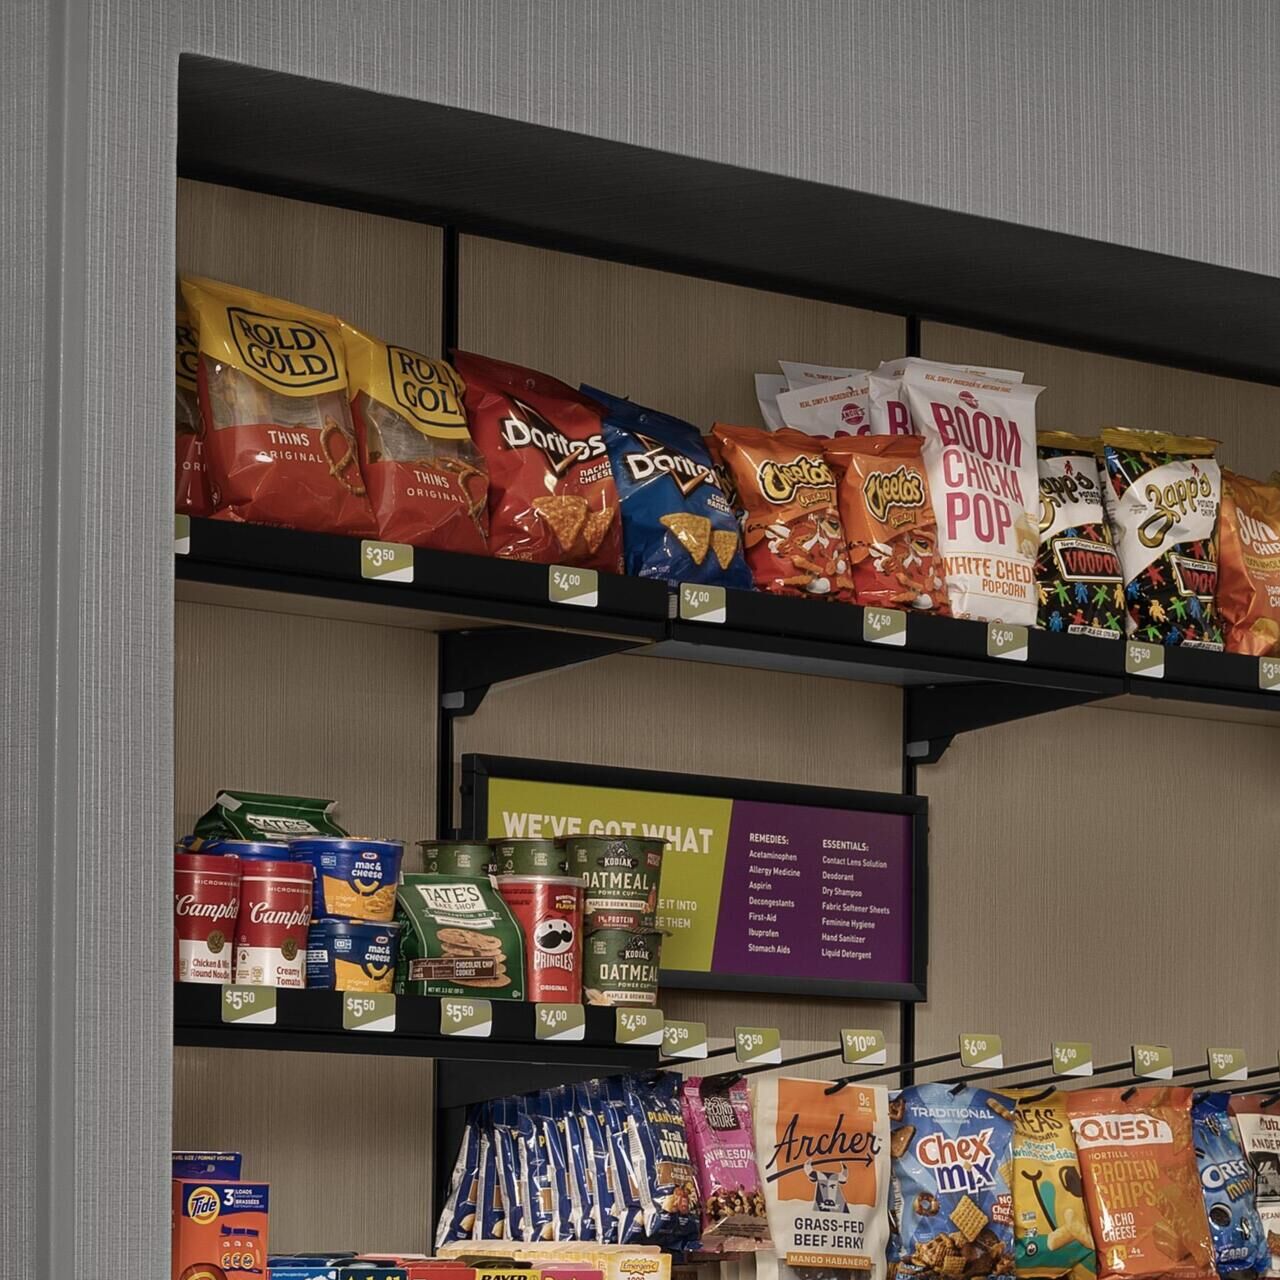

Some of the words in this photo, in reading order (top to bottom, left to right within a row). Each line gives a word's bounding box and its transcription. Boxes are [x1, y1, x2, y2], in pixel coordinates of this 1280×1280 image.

[238, 314, 319, 351] ROLD
[248, 342, 329, 376] GOLD
[268, 430, 310, 447] THINS
[502, 415, 606, 460] Doritos
[932, 401, 1023, 467] BOOM
[259, 450, 323, 464] ORIGINAL
[943, 449, 1025, 506] CHICKA
[865, 471, 924, 521] Cheetos
[946, 492, 1012, 545] POP
[503, 811, 582, 838] WE'VE
[749, 833, 789, 845] REMEDIES:
[823, 840, 869, 852] ESSENTIALS:
[604, 857, 632, 867] KODIAK
[748, 850, 797, 861] Acetaminophen
[821, 855, 844, 865] Contact
[845, 856, 861, 866] Lens
[862, 857, 887, 868] Solution
[748, 865, 771, 877] Allergy
[772, 866, 800, 877] Medicine
[821, 870, 854, 881] Deodorant
[748, 880, 771, 891] Aspirin
[821, 886, 835, 896] Dry
[835, 887, 862, 897] Shampoo
[424, 885, 480, 905] TATE'S
[748, 896, 795, 908] Decongestants
[677, 900, 697, 912] INTO
[821, 901, 841, 912] Fabric
[842, 902, 868, 913] Softener
[869, 904, 890, 914] Sheets
[666, 917, 691, 928] THEM
[748, 912, 777, 922] First-Aid
[821, 918, 849, 927] Feminine
[850, 918, 875, 929] Hygiene
[747, 928, 779, 938] Ibuprofen
[821, 933, 838, 942] Hand
[838, 934, 865, 944] Sanitizer
[747, 943, 775, 953] Stomach
[776, 944, 791, 953] Aids
[821, 949, 840, 959] Liquid
[841, 949, 871, 960] Detergent
[534, 951, 573, 971] PRINGLES
[540, 984, 568, 992] ORIGINAL
[911, 1105, 994, 1120] TRADITIONAL
[1079, 1118, 1161, 1141] QUEST
[767, 1113, 880, 1168] Archer
[916, 1131, 991, 1165] Chex
[936, 1161, 995, 1192] mix
[188, 1196, 218, 1218] Tide
[794, 1217, 865, 1234] GRASS-FED
[794, 1233, 826, 1247] BEEF
[829, 1234, 865, 1250] JERKY
[789, 1254, 822, 1267] MANGO
[824, 1255, 870, 1268] HABANERO
